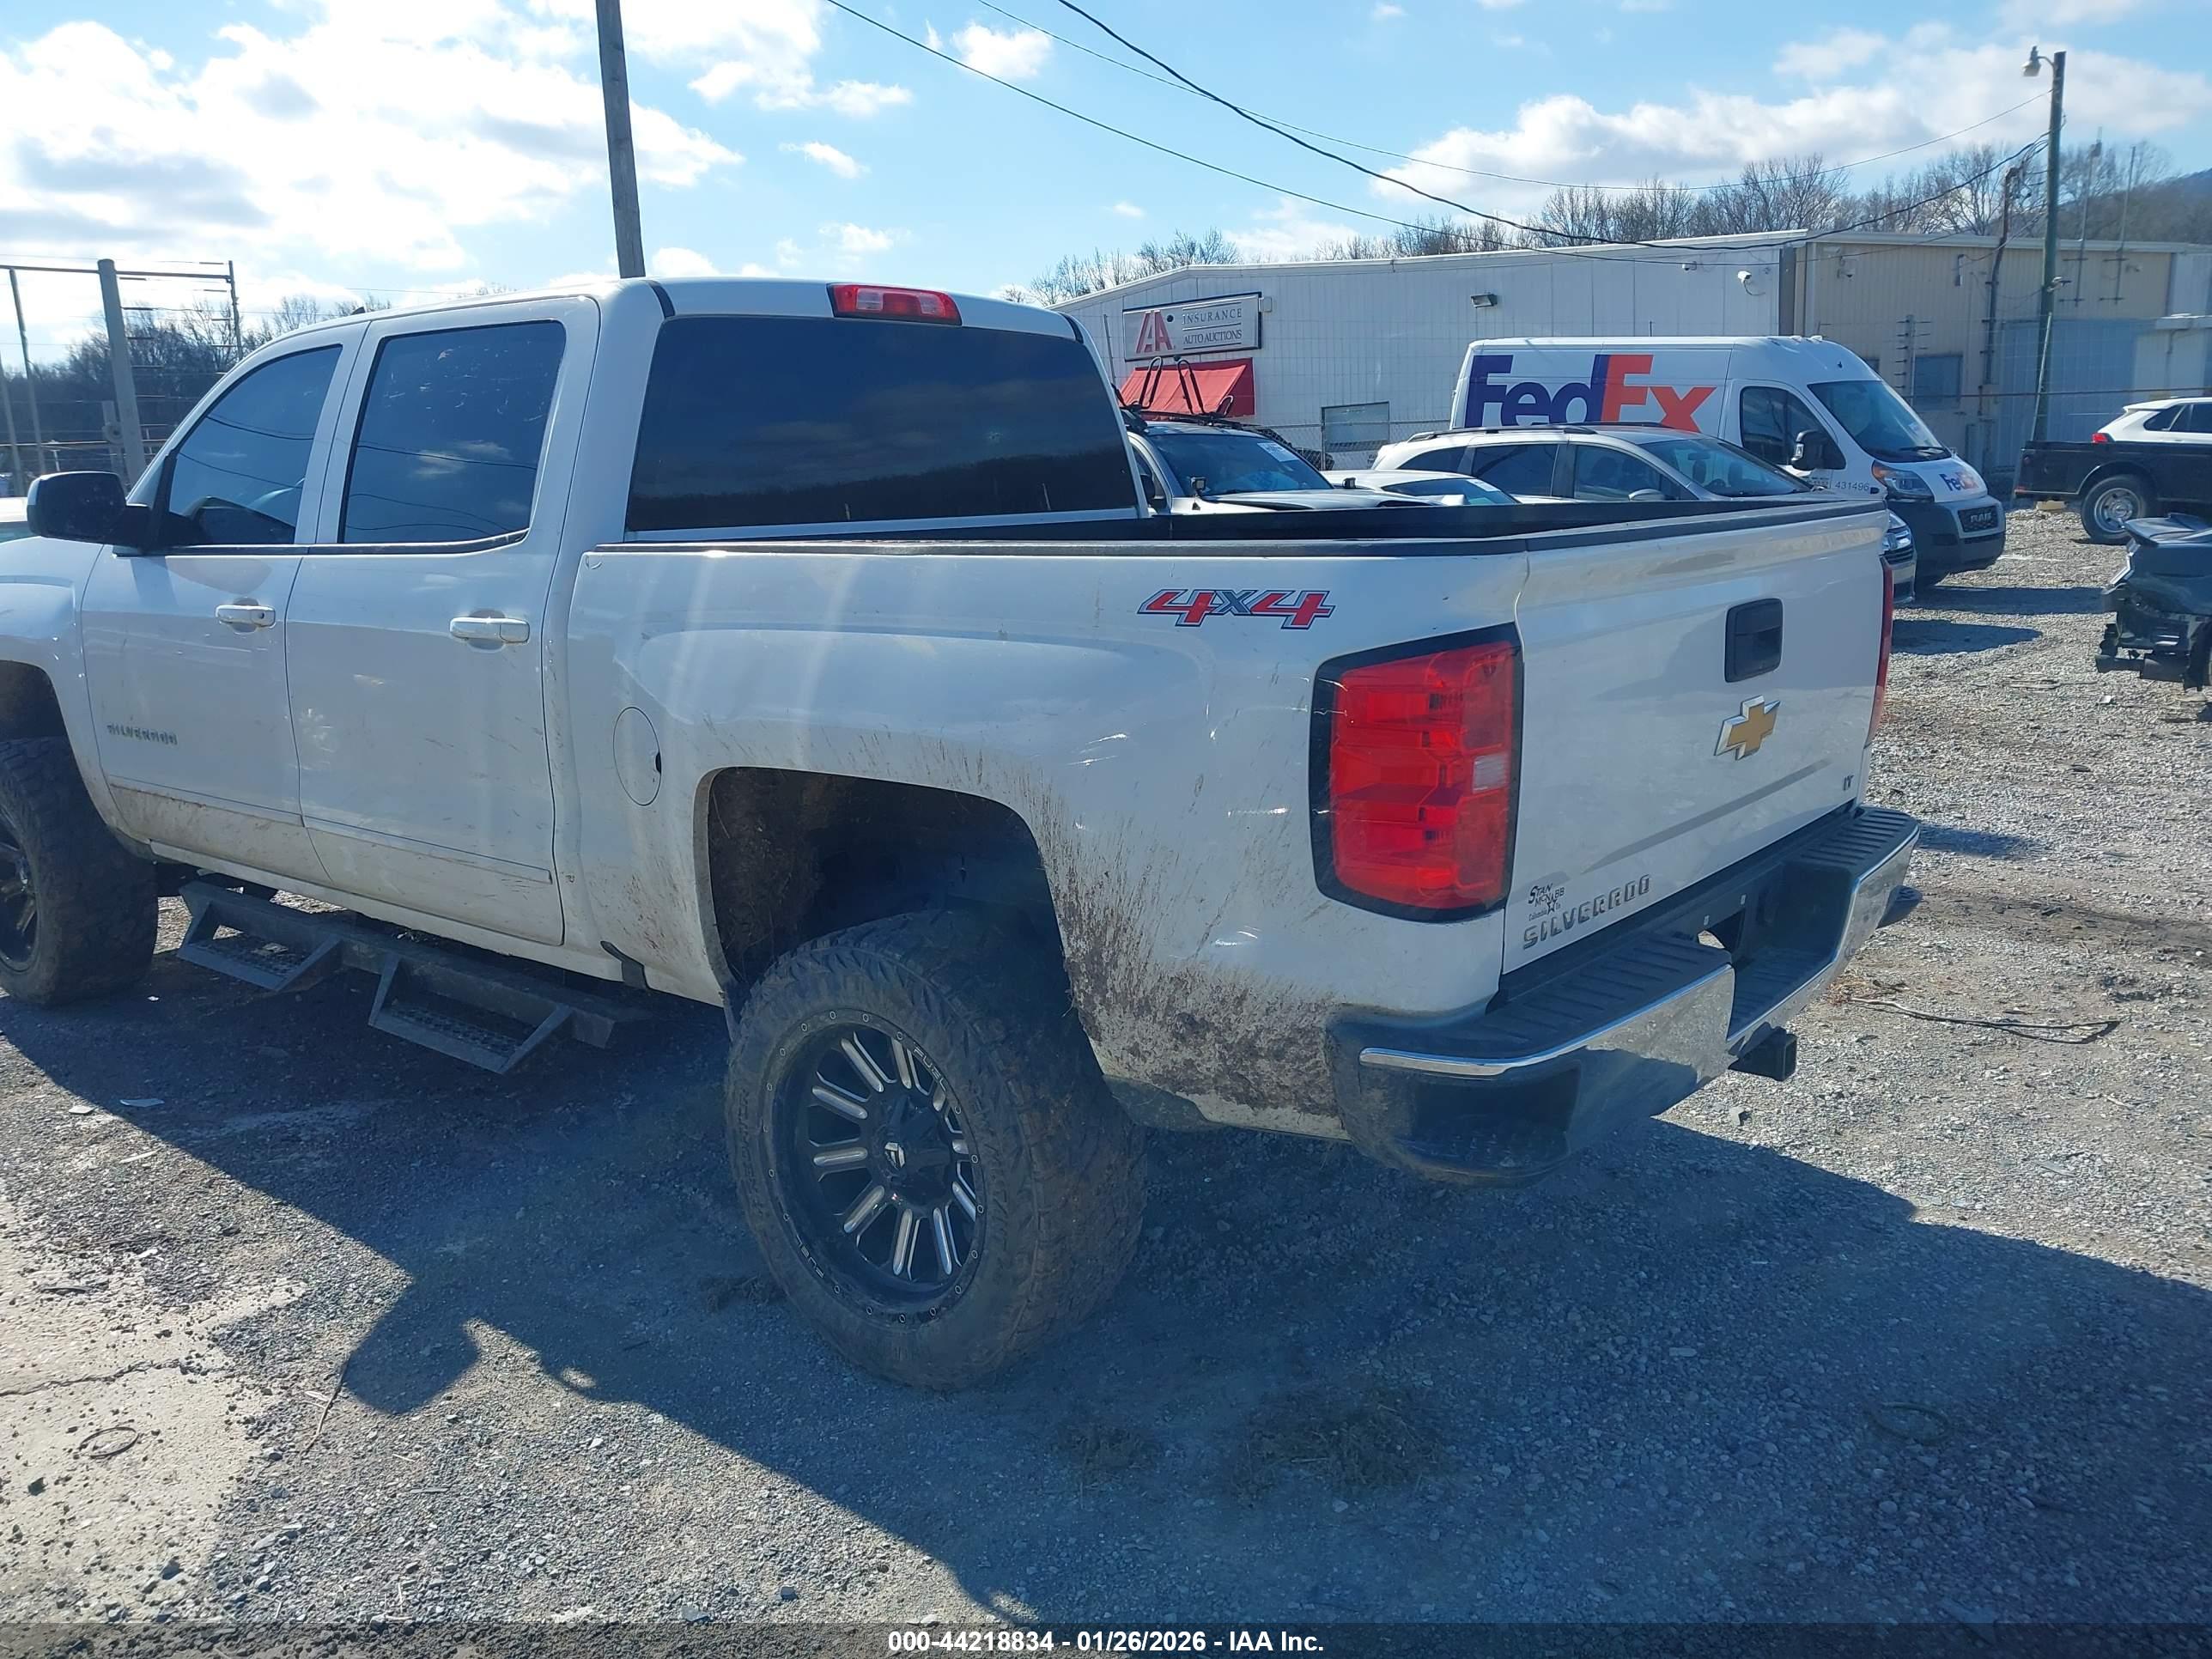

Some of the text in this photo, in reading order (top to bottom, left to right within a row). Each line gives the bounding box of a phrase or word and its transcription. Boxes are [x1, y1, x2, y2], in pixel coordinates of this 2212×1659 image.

[1182, 307, 1242, 325] INSURANCE
[1183, 330, 1243, 344] AUTO AUCTIONS
[1464, 354, 1717, 433] FedEx
[1835, 480, 1869, 491] 431496
[1523, 874, 1650, 951] SILVERADO
[913, 1046, 946, 1091] FUEL
[796, 1234, 824, 1279] FUEL
